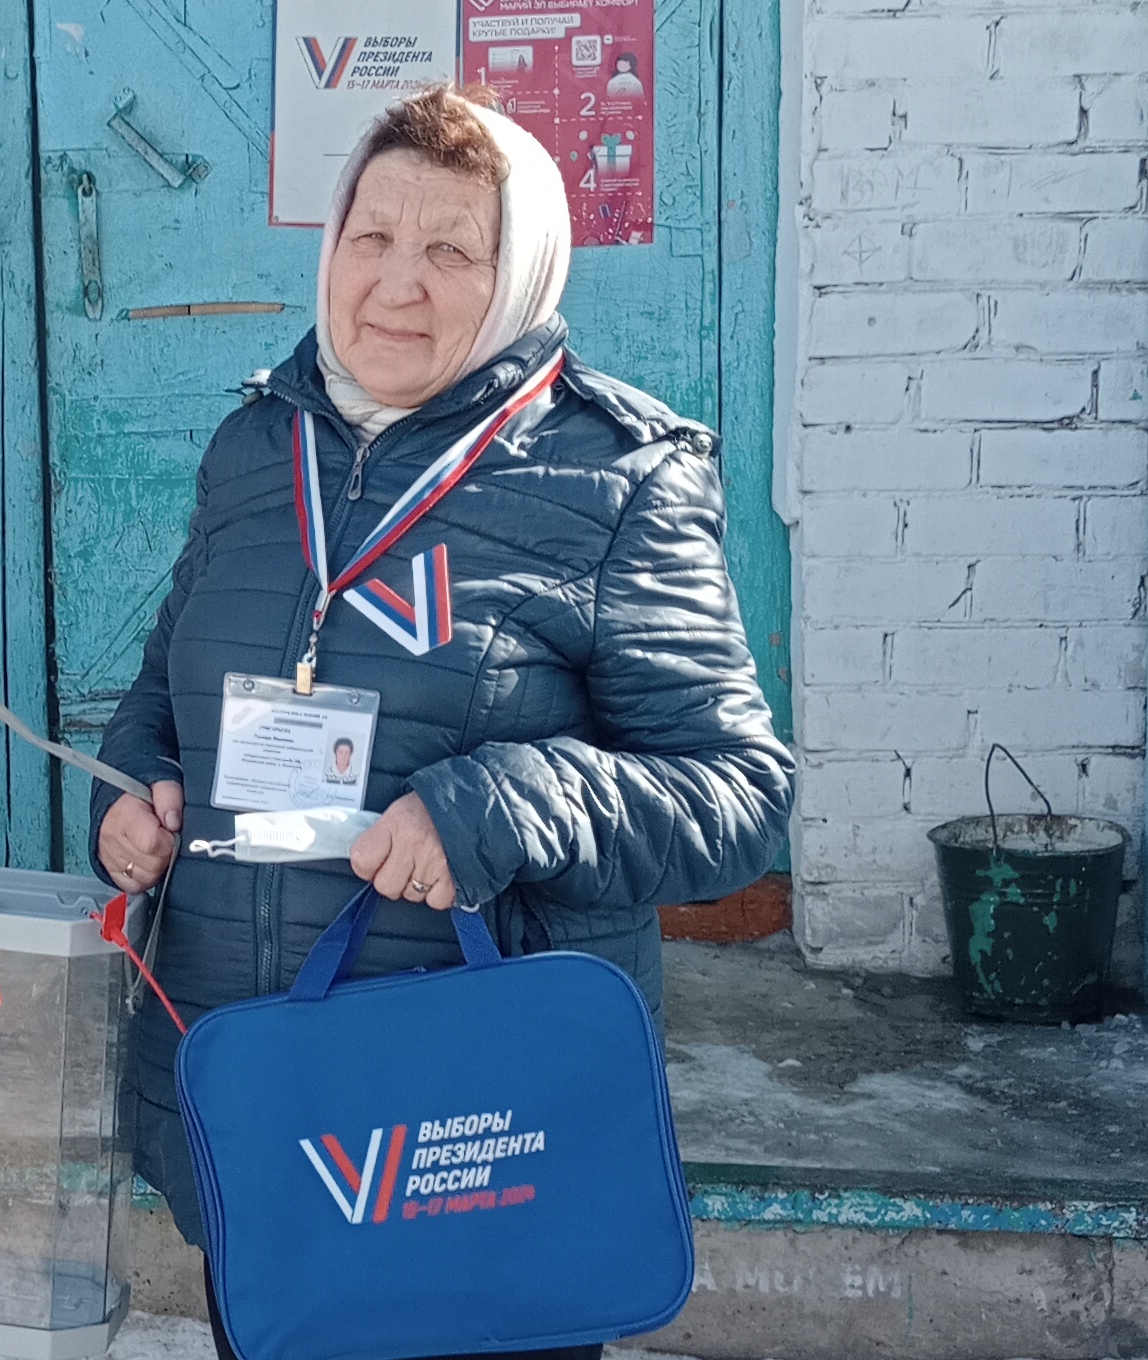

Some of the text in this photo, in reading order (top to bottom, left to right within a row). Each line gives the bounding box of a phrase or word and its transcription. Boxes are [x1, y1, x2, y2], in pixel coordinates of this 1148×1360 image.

[472, 17, 519, 28] УЧАСТВУЙ
[530, 14, 574, 26] ПОЛУЧАЙ
[472, 28, 508, 38] КРУТЫЕ
[363, 36, 418, 48] ВЫБОРЫ
[356, 50, 433, 64] ПРЕЗИДЕНТА
[350, 65, 401, 78] РОССИИ
[370, 79, 400, 90] МАРТА
[579, 91, 597, 117] 2
[578, 168, 598, 192] 4
[417, 1109, 513, 1143] ВЫБОРЫ
[411, 1131, 545, 1170] ПРЕЗИДЕНТА
[405, 1165, 492, 1197] РОССИИ
